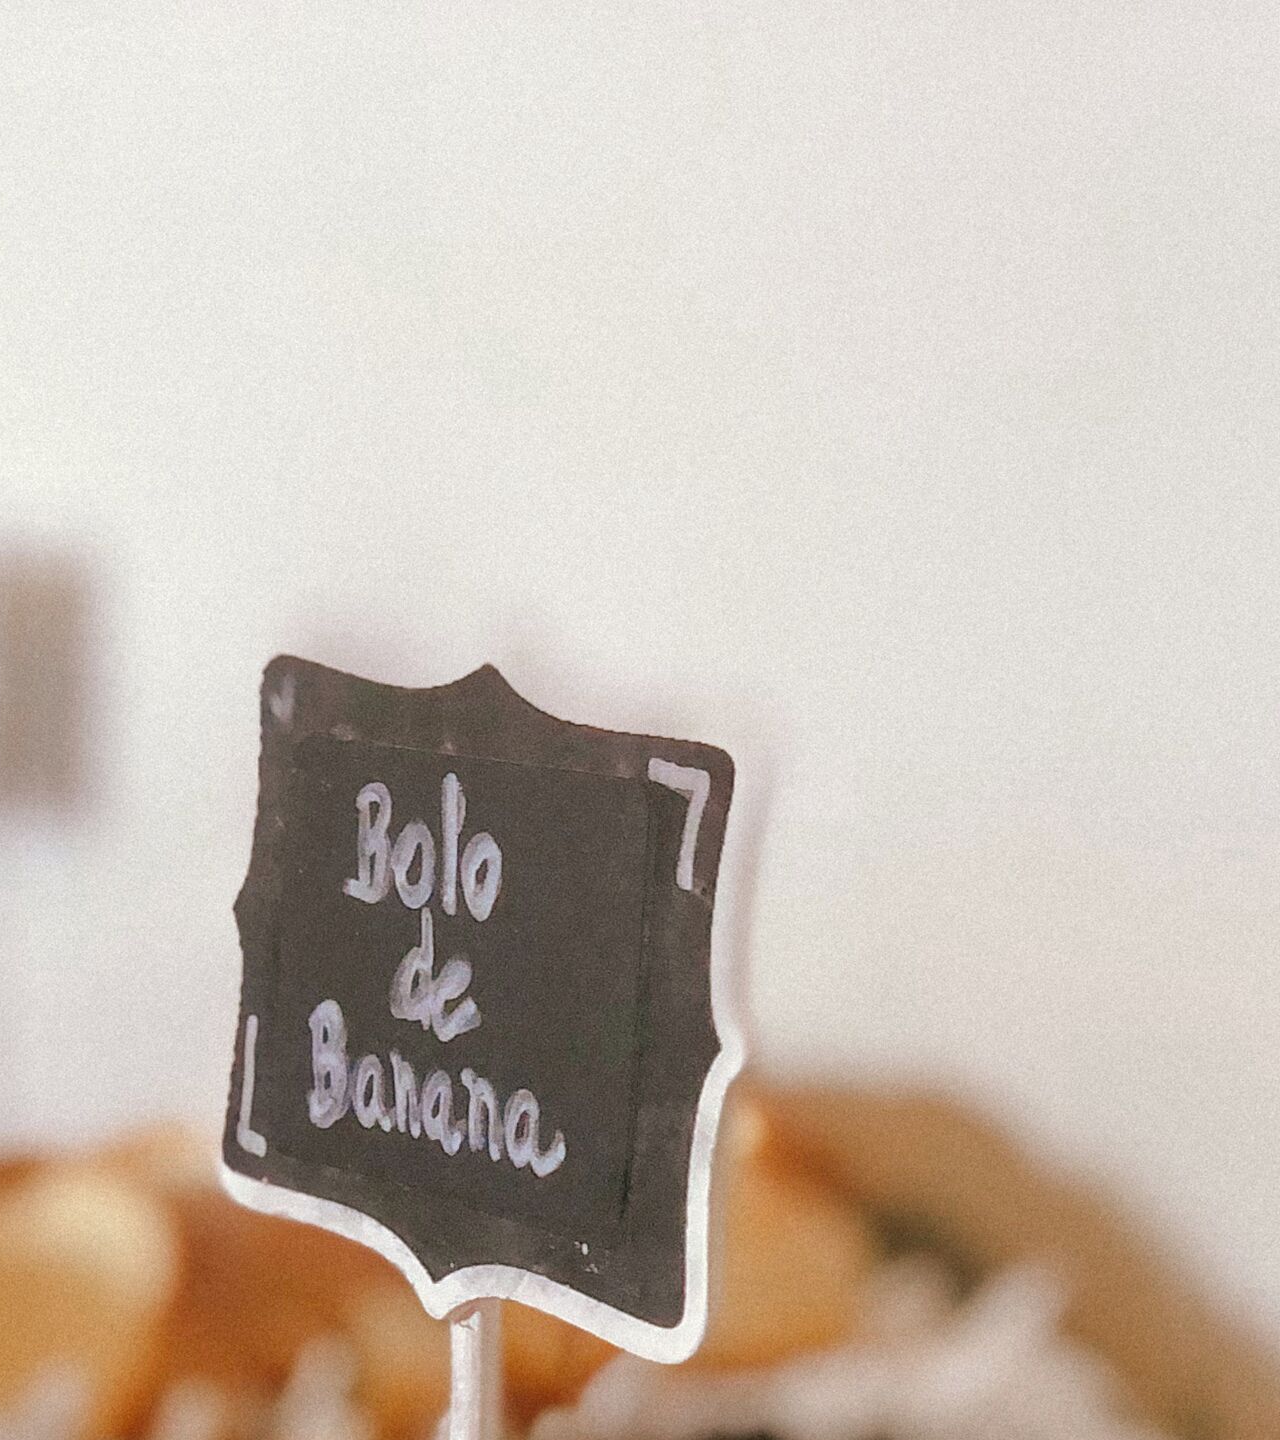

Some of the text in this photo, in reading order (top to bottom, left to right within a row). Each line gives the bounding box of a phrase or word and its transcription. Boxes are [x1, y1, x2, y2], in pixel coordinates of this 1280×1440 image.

[343, 773, 502, 921] Bolo
[390, 908, 482, 1042] de
[308, 999, 566, 1176] Banana
